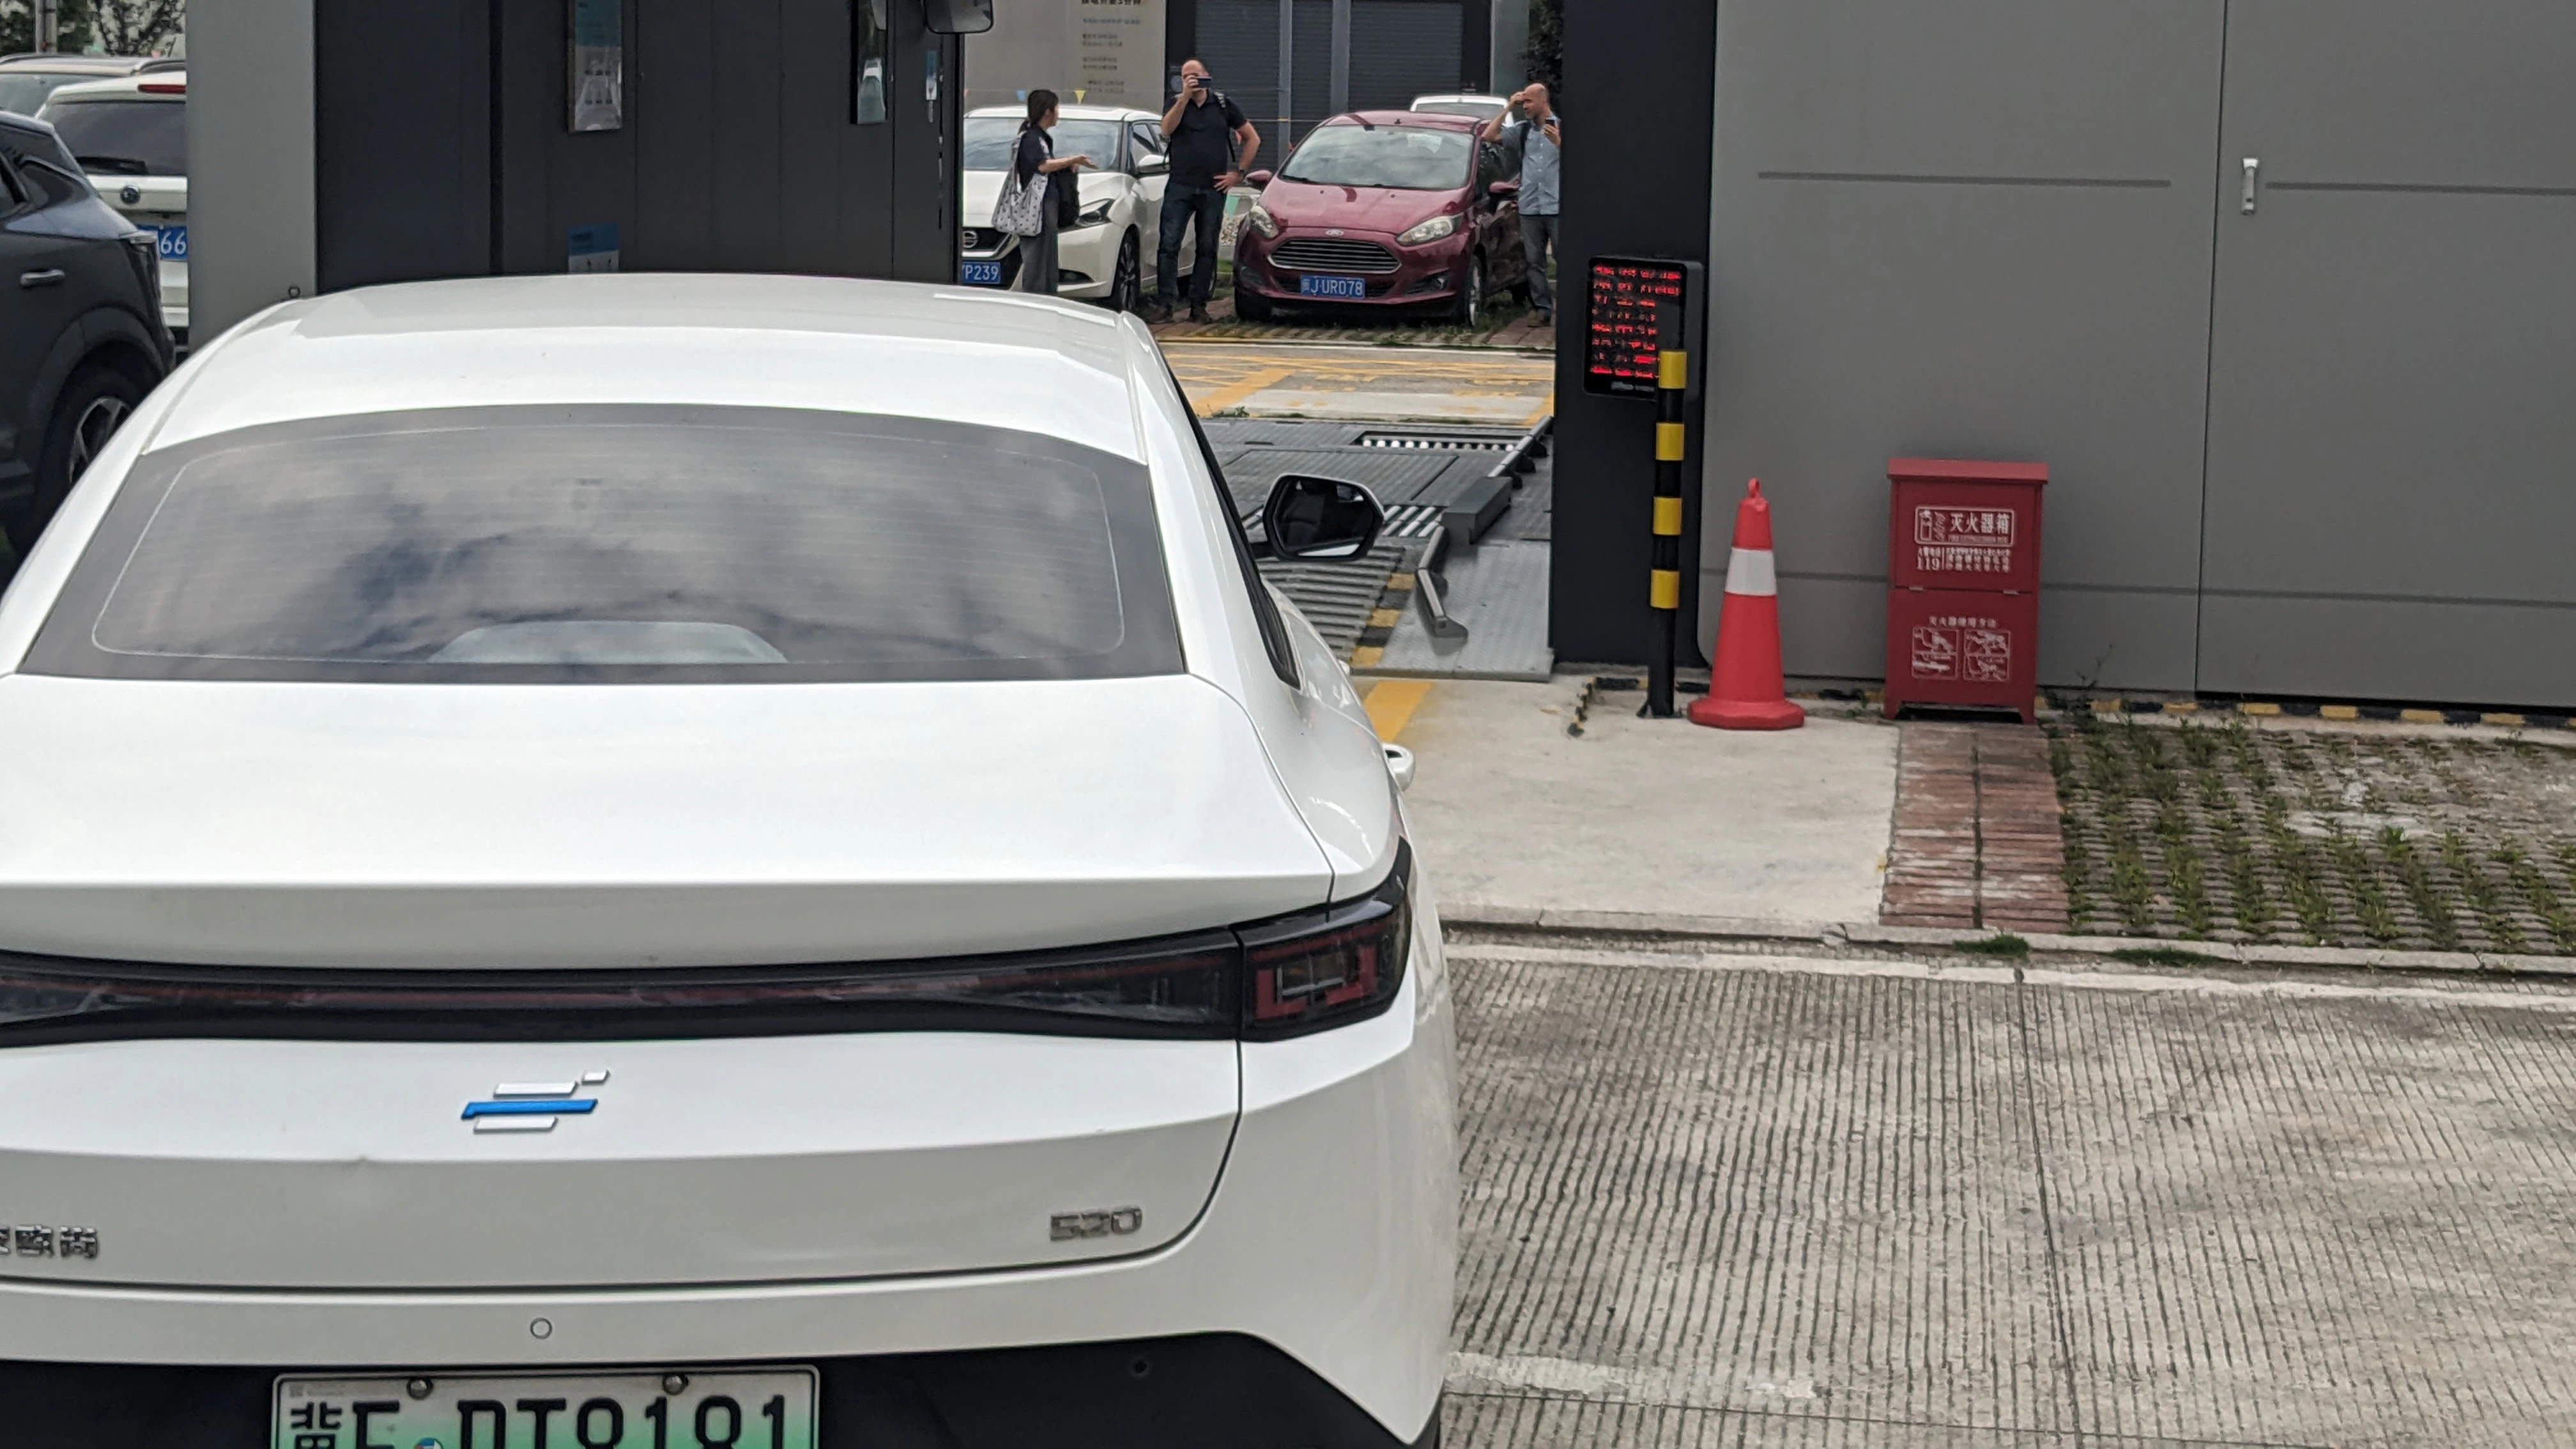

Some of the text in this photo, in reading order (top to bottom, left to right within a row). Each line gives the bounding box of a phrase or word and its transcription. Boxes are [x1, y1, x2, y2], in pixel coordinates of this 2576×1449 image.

[1950, 512, 2009, 535] 灭火器箱
[1917, 556, 1940, 571] 119
[1050, 1208, 1143, 1241] 520
[0, 1223, 100, 1259] 欧尚
